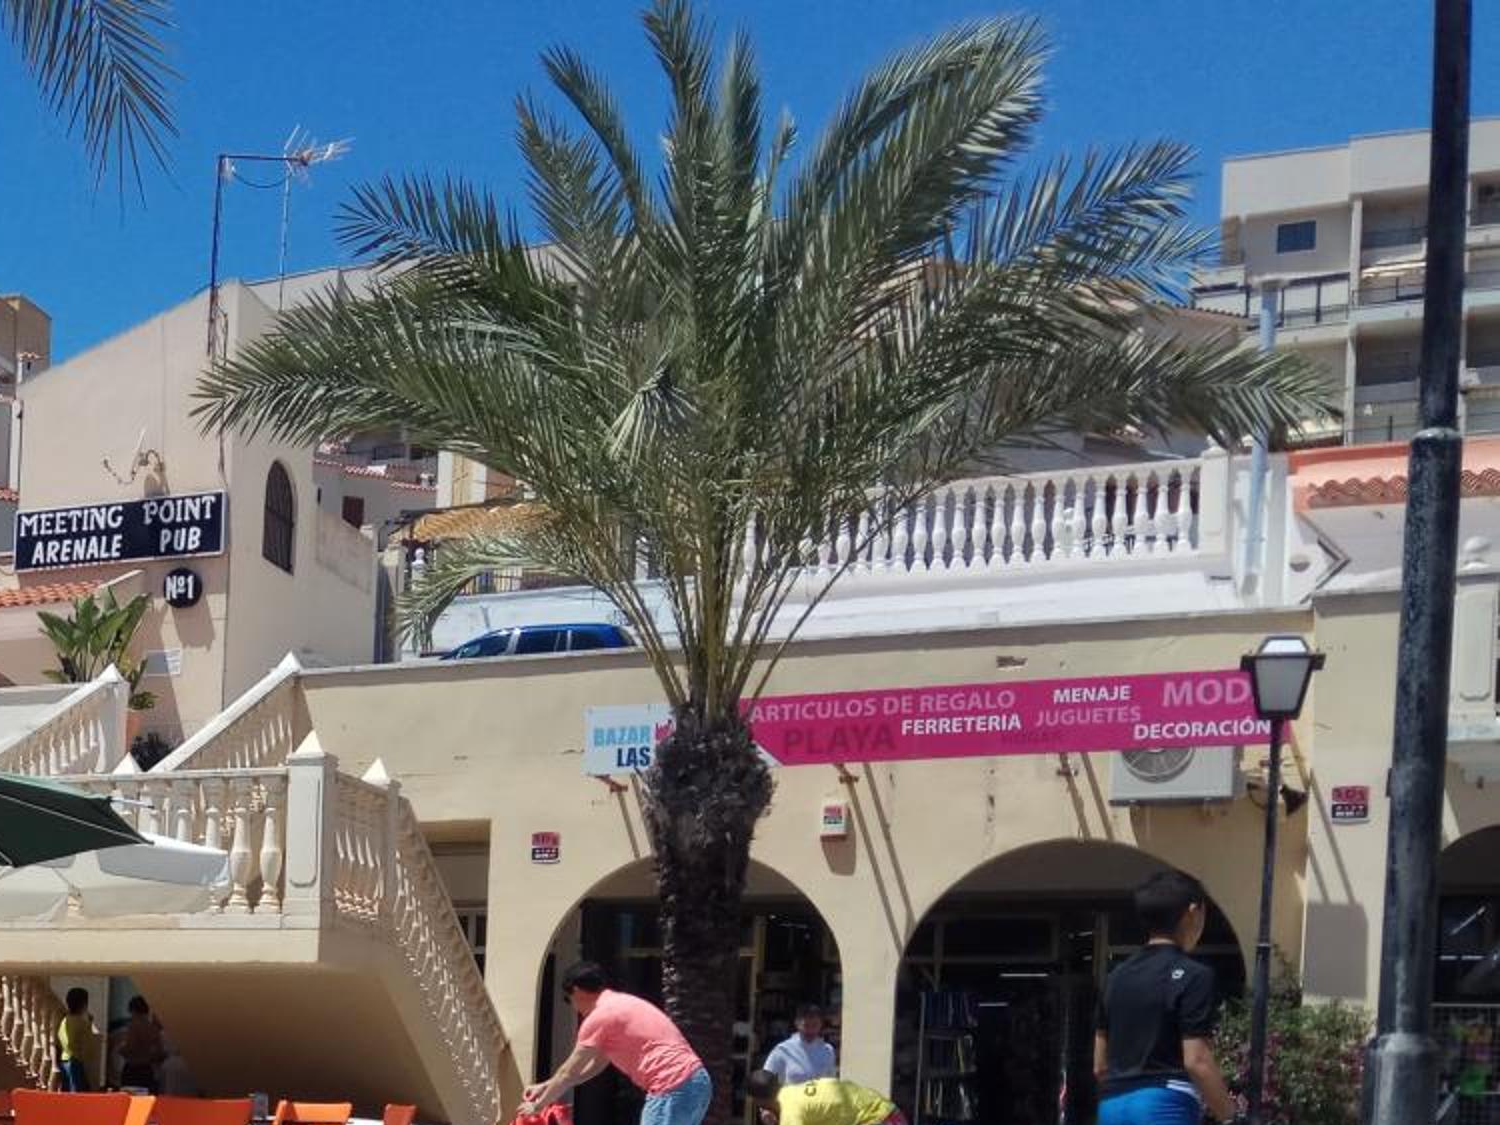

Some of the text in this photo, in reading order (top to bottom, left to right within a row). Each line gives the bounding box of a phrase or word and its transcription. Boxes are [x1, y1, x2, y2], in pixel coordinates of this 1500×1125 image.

[20, 495, 216, 538] MEETING POINT
[32, 528, 201, 565] ARENALE PUB
[750, 689, 1016, 722] ARTICULOS DE REGALO
[1053, 685, 1132, 704] MENAJE
[1161, 678, 1252, 707] MOD
[1035, 706, 1141, 727] JUGUETES
[1133, 716, 1272, 740] DECORACIÓN
[593, 726, 650, 747] BAZAR
[784, 725, 897, 755] PLAYA
[617, 747, 650, 767] LAS
